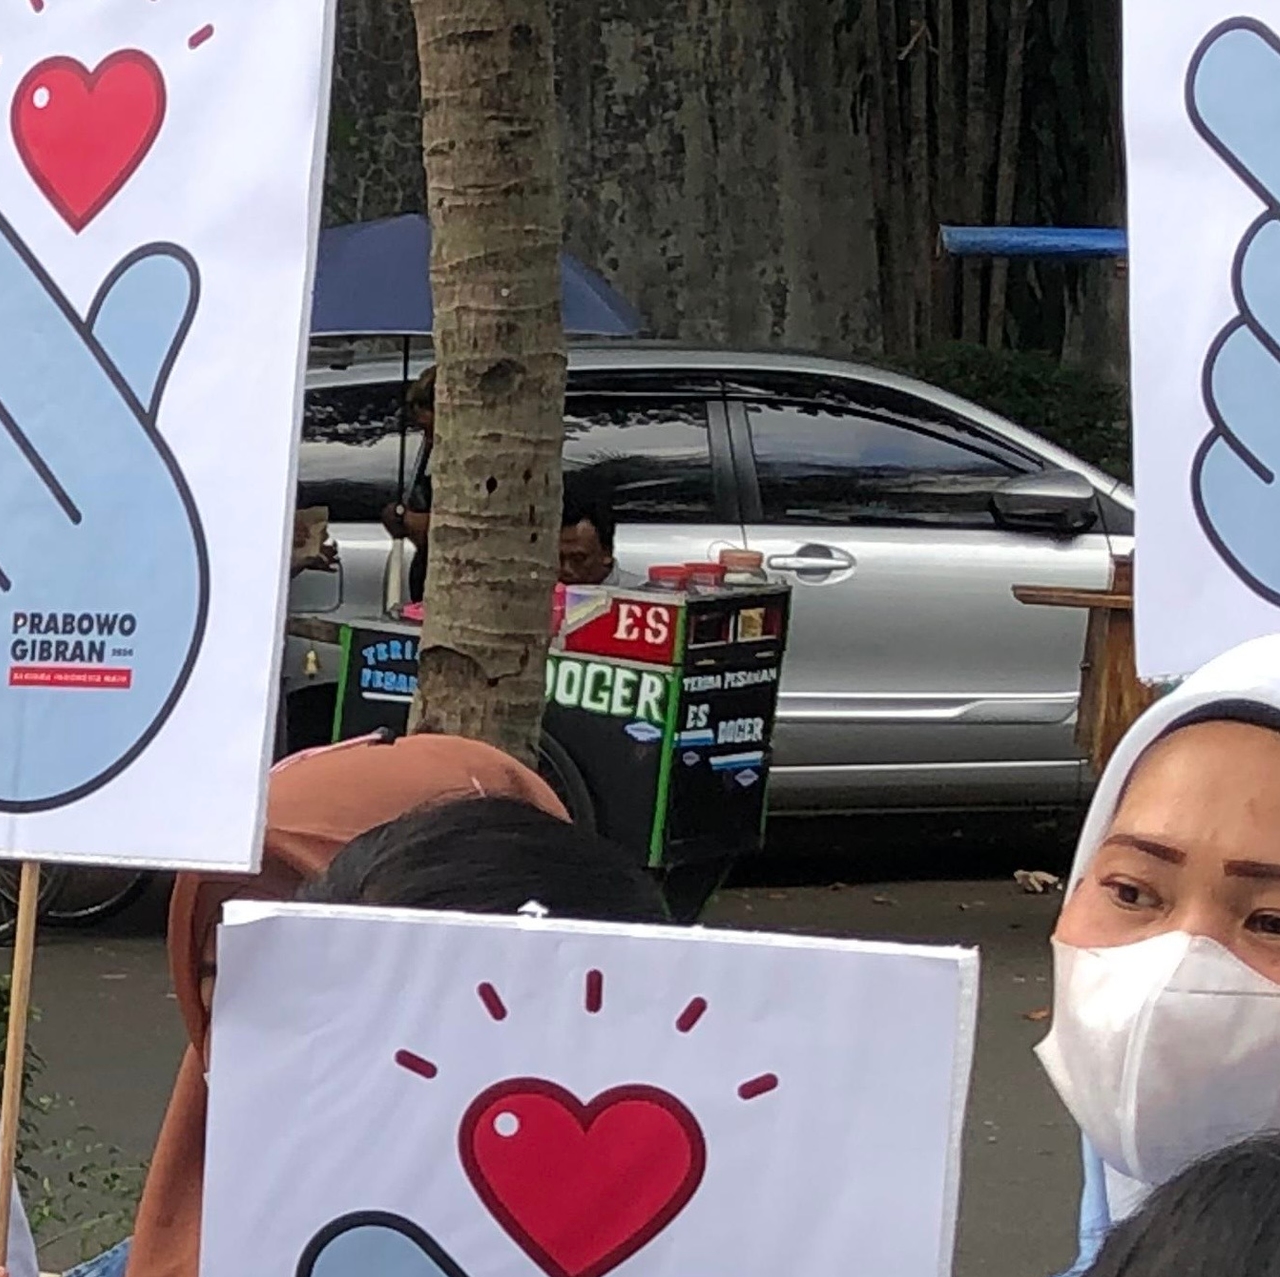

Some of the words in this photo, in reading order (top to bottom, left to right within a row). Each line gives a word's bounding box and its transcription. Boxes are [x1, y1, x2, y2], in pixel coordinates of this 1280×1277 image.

[12, 612, 137, 637] PRABOWO
[613, 603, 670, 644] ES
[11, 639, 106, 663] GIBRAN
[686, 703, 710, 729] ES
